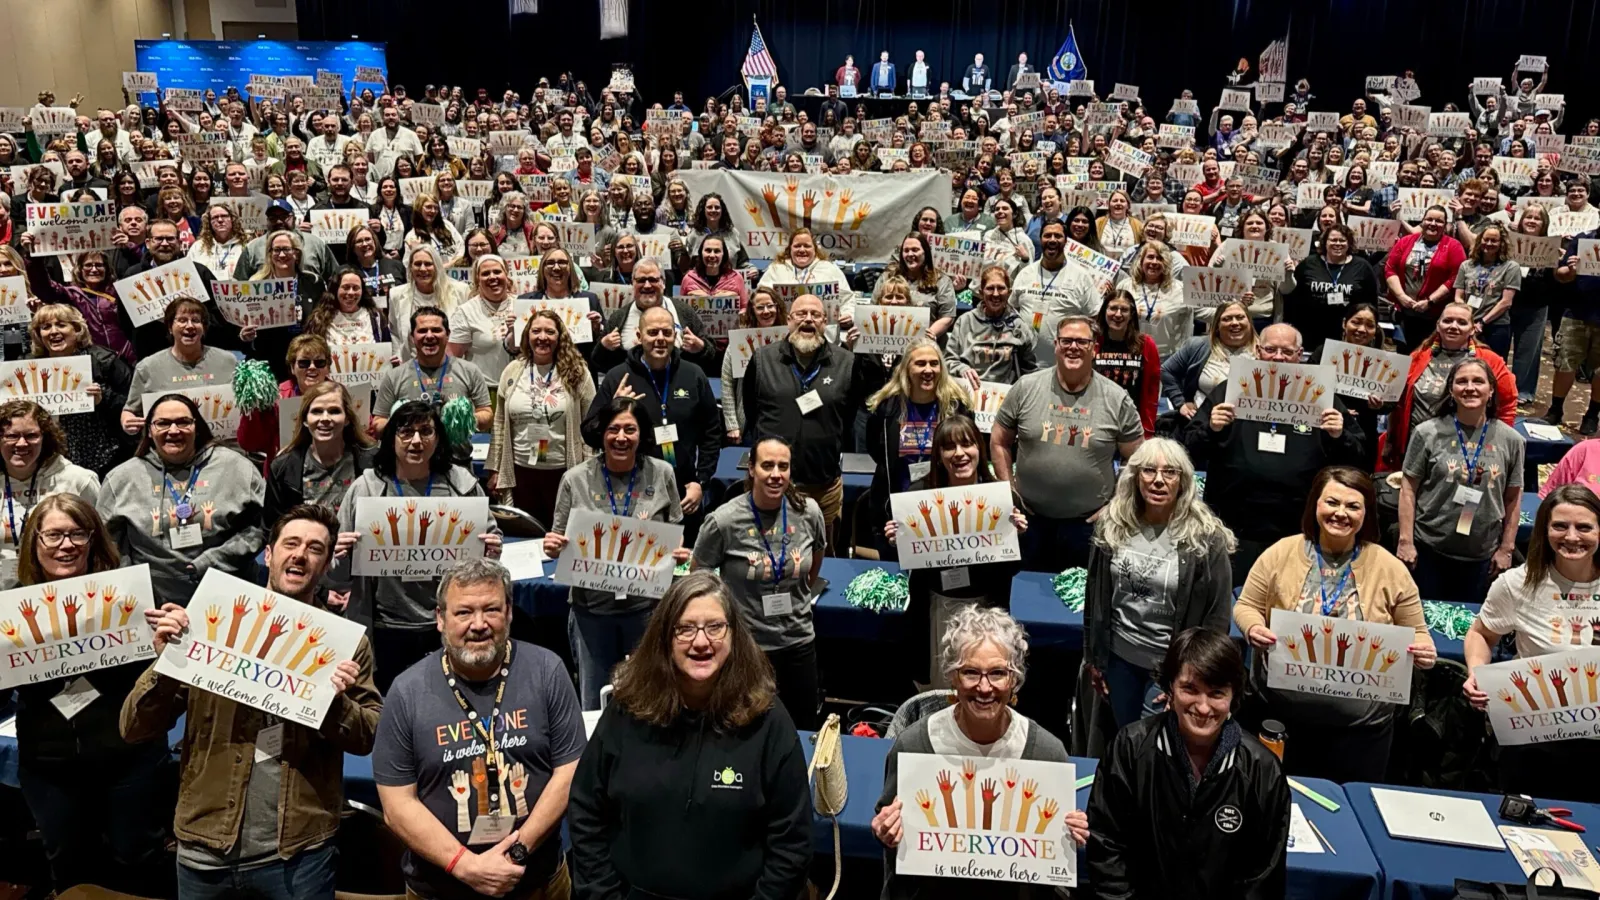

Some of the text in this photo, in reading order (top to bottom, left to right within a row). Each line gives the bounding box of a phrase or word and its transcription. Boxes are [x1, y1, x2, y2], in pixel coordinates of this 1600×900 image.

[1058, 174, 1088, 182] EVEYO
[28, 203, 115, 219] EVERYONE
[40, 214, 88, 226] welcome
[93, 209, 116, 224] here
[536, 213, 567, 222] YONE
[747, 231, 870, 249] EVEONE
[928, 233, 986, 253] EVERYONE
[935, 244, 985, 258] welcome here
[1067, 241, 1120, 273] VERYONE
[506, 258, 539, 270] EVER
[516, 266, 539, 278] welc
[1067, 250, 1115, 278] welcome here
[213, 280, 294, 295] EVERYONE
[225, 291, 269, 303] welcome
[272, 288, 294, 300] here
[682, 298, 740, 310] ERYONE
[821, 291, 840, 302] here
[1191, 292, 1235, 302] EVERYON
[694, 303, 740, 315] lcome here
[862, 336, 913, 346] EVERYON
[59, 405, 77, 417] here
[1237, 398, 1322, 418] EVERYONE
[1246, 411, 1309, 426] is welcome here
[911, 533, 1005, 555] EVERYONE
[369, 547, 471, 562] EVERYONE
[925, 559, 933, 569] is
[935, 555, 973, 569] welcome
[975, 551, 997, 566] here
[380, 566, 387, 575] is
[392, 564, 433, 576] welcome
[572, 559, 661, 583] EVERYONE
[579, 577, 648, 597] is welcome here
[8, 627, 140, 669] EVERYONE
[136, 644, 154, 654] IEA
[29, 673, 40, 683] is
[44, 661, 97, 680] welcome
[99, 653, 130, 671] here
[186, 640, 318, 703] EVERYONE
[1285, 664, 1396, 689] EVERYONE
[192, 673, 293, 718] is welcome here
[1297, 684, 1306, 693] is
[1309, 683, 1354, 700] welcome
[1355, 693, 1382, 701] here
[1389, 691, 1404, 700] IEA
[301, 706, 317, 718] IEA
[1508, 705, 1600, 730] EVERYO
[436, 708, 529, 746] EVEYONE
[1530, 727, 1591, 743] is welcome
[443, 733, 529, 763] is welcoe here
[918, 831, 1057, 861] EVERYONE
[934, 864, 945, 876] is
[950, 860, 1006, 879] welcome
[1008, 861, 1041, 882] here
[1051, 866, 1068, 876] IEA
